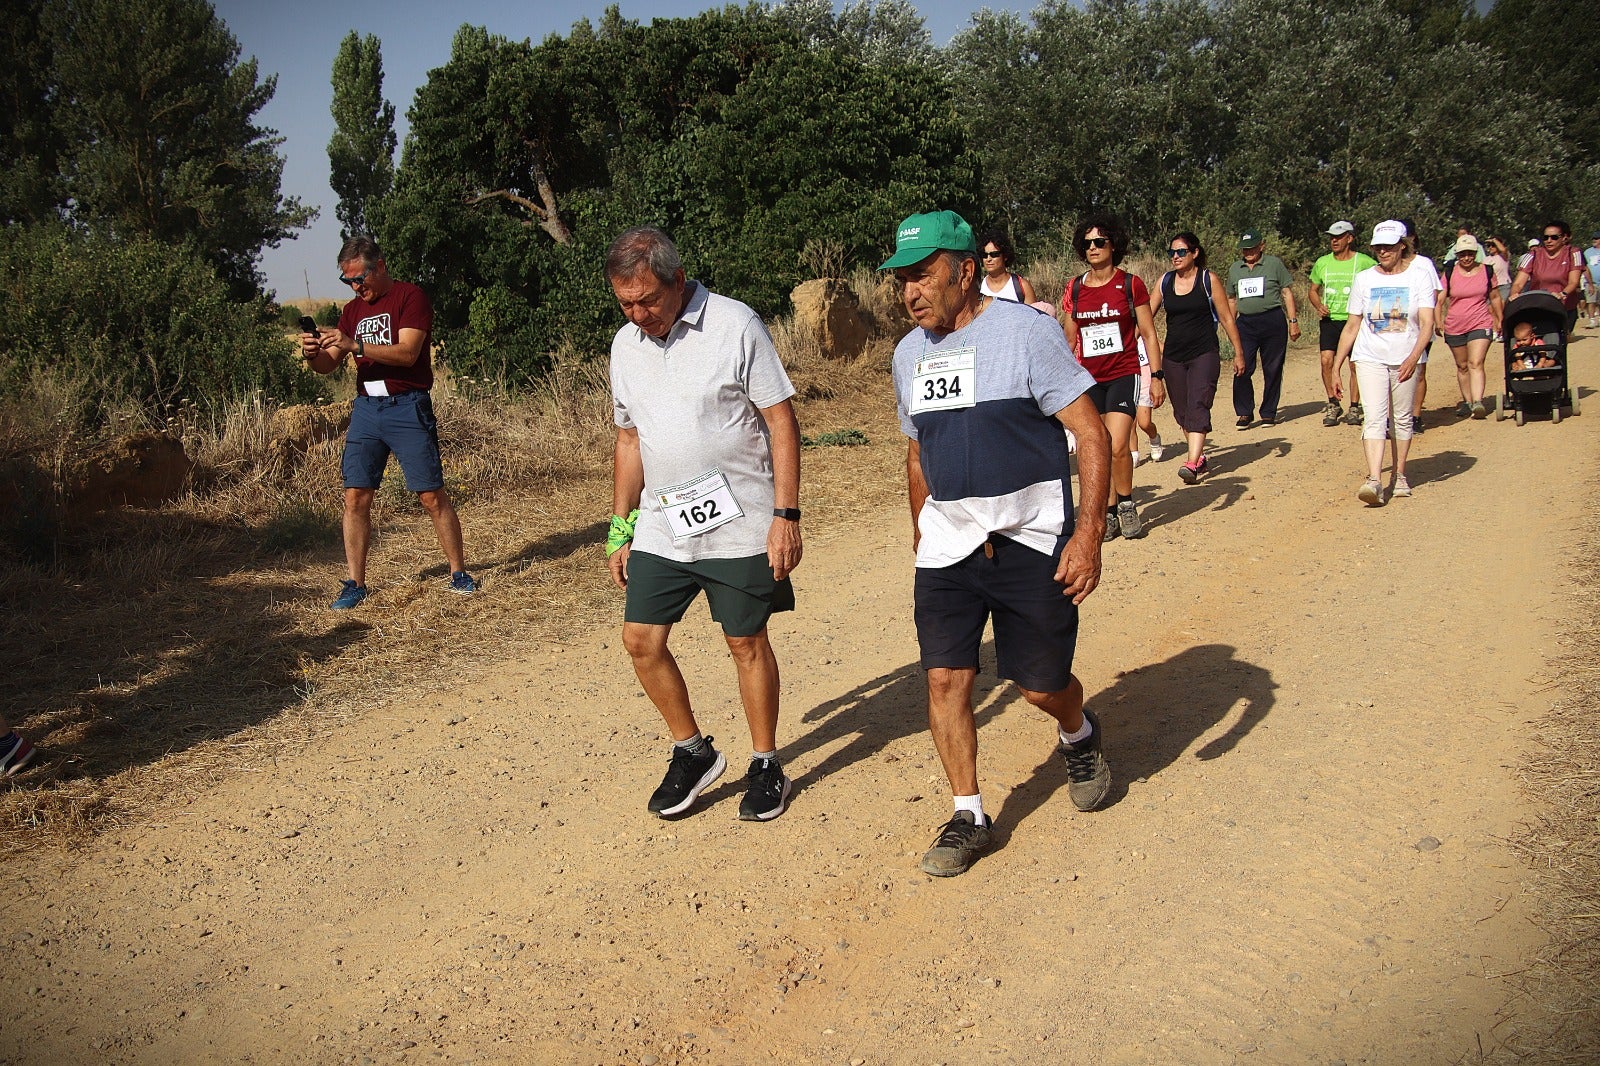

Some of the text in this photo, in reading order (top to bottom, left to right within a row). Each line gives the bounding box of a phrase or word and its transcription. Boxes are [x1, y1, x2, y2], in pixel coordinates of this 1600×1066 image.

[1243, 286, 1258, 294] 160
[1092, 337, 1114, 351] 384
[923, 375, 962, 401] 334
[679, 499, 722, 528] 162
